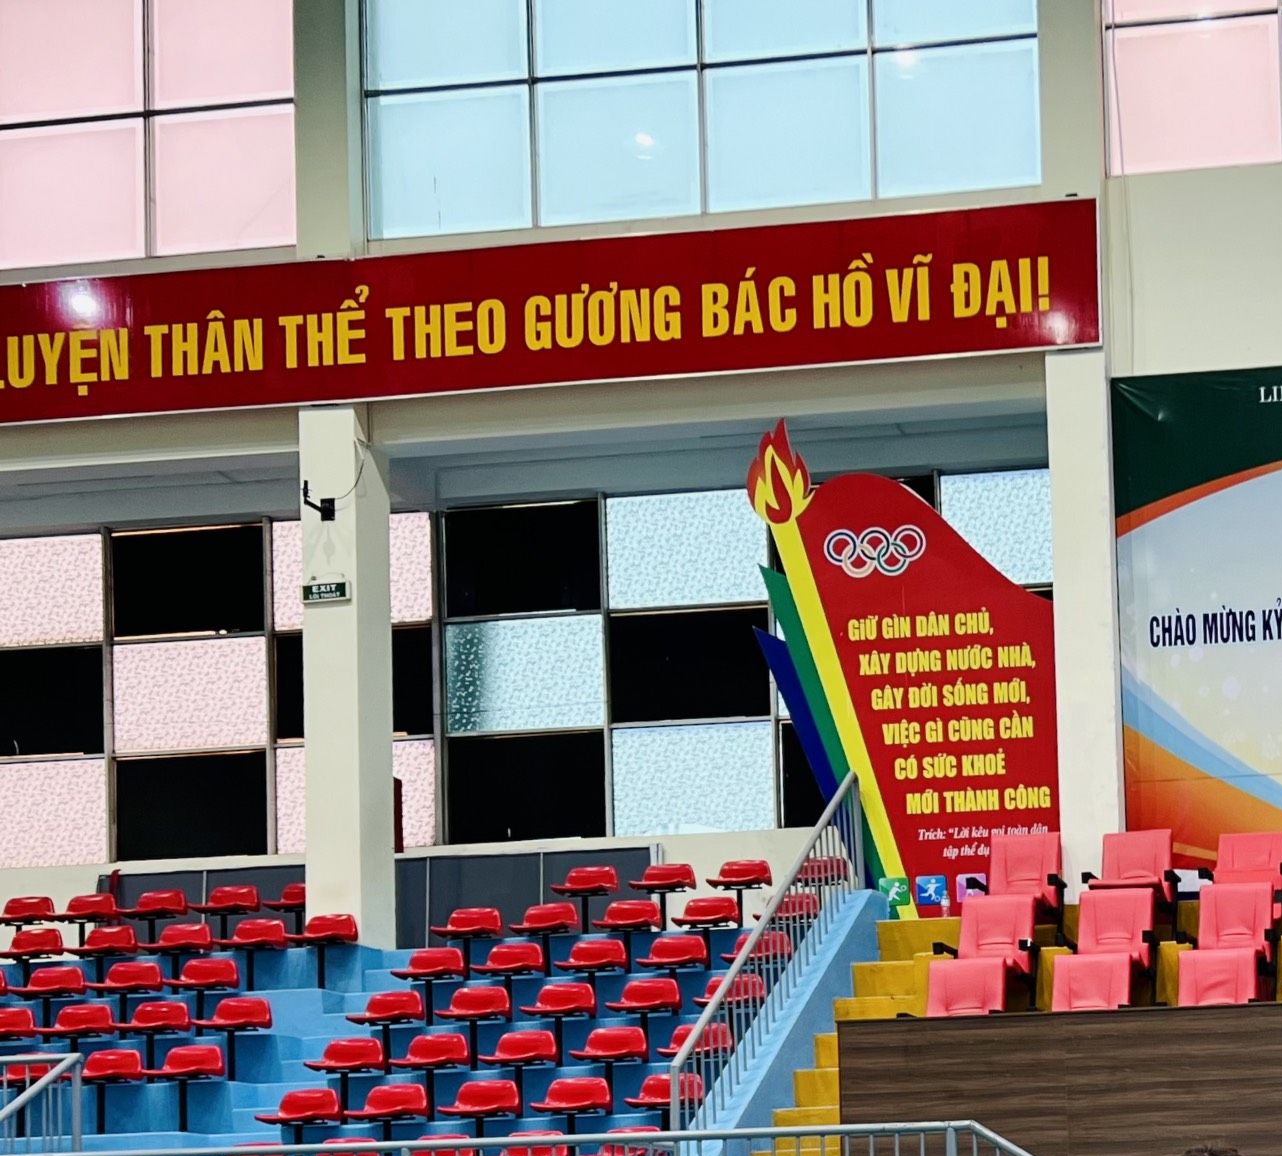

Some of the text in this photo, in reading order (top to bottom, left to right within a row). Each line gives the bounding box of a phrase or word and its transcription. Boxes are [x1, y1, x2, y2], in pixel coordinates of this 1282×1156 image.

[0, 252, 1050, 396] UYỆN THÂN THỂ THEO GƯƠNG BÁC HỒ VĨ ĐẠI!
[312, 584, 337, 593] EXIT
[882, 613, 911, 639] GÌN
[916, 611, 950, 637] DÂN
[955, 607, 994, 635] CHỦ,
[1150, 608, 1197, 648] CHÀO
[1203, 605, 1256, 645] MỪNG
[859, 642, 1035, 677] XÂY DỰNG NƯỚC NHÀ,
[871, 684, 904, 711] GÂY
[908, 682, 938, 708] ĐỜI
[942, 677, 989, 707] SỐNG
[882, 709, 1034, 748] VIỆC GÌ CŨNG CẦN
[894, 748, 1006, 780] CÓ SỨC KHOẺ
[906, 784, 1051, 815] MỚI THÀNH CÔNG
[918, 828, 946, 841] Trích:
[971, 826, 989, 838] kêu
[1030, 823, 1048, 834] dân
[943, 845, 959, 859] tập
[960, 842, 977, 857] thể
